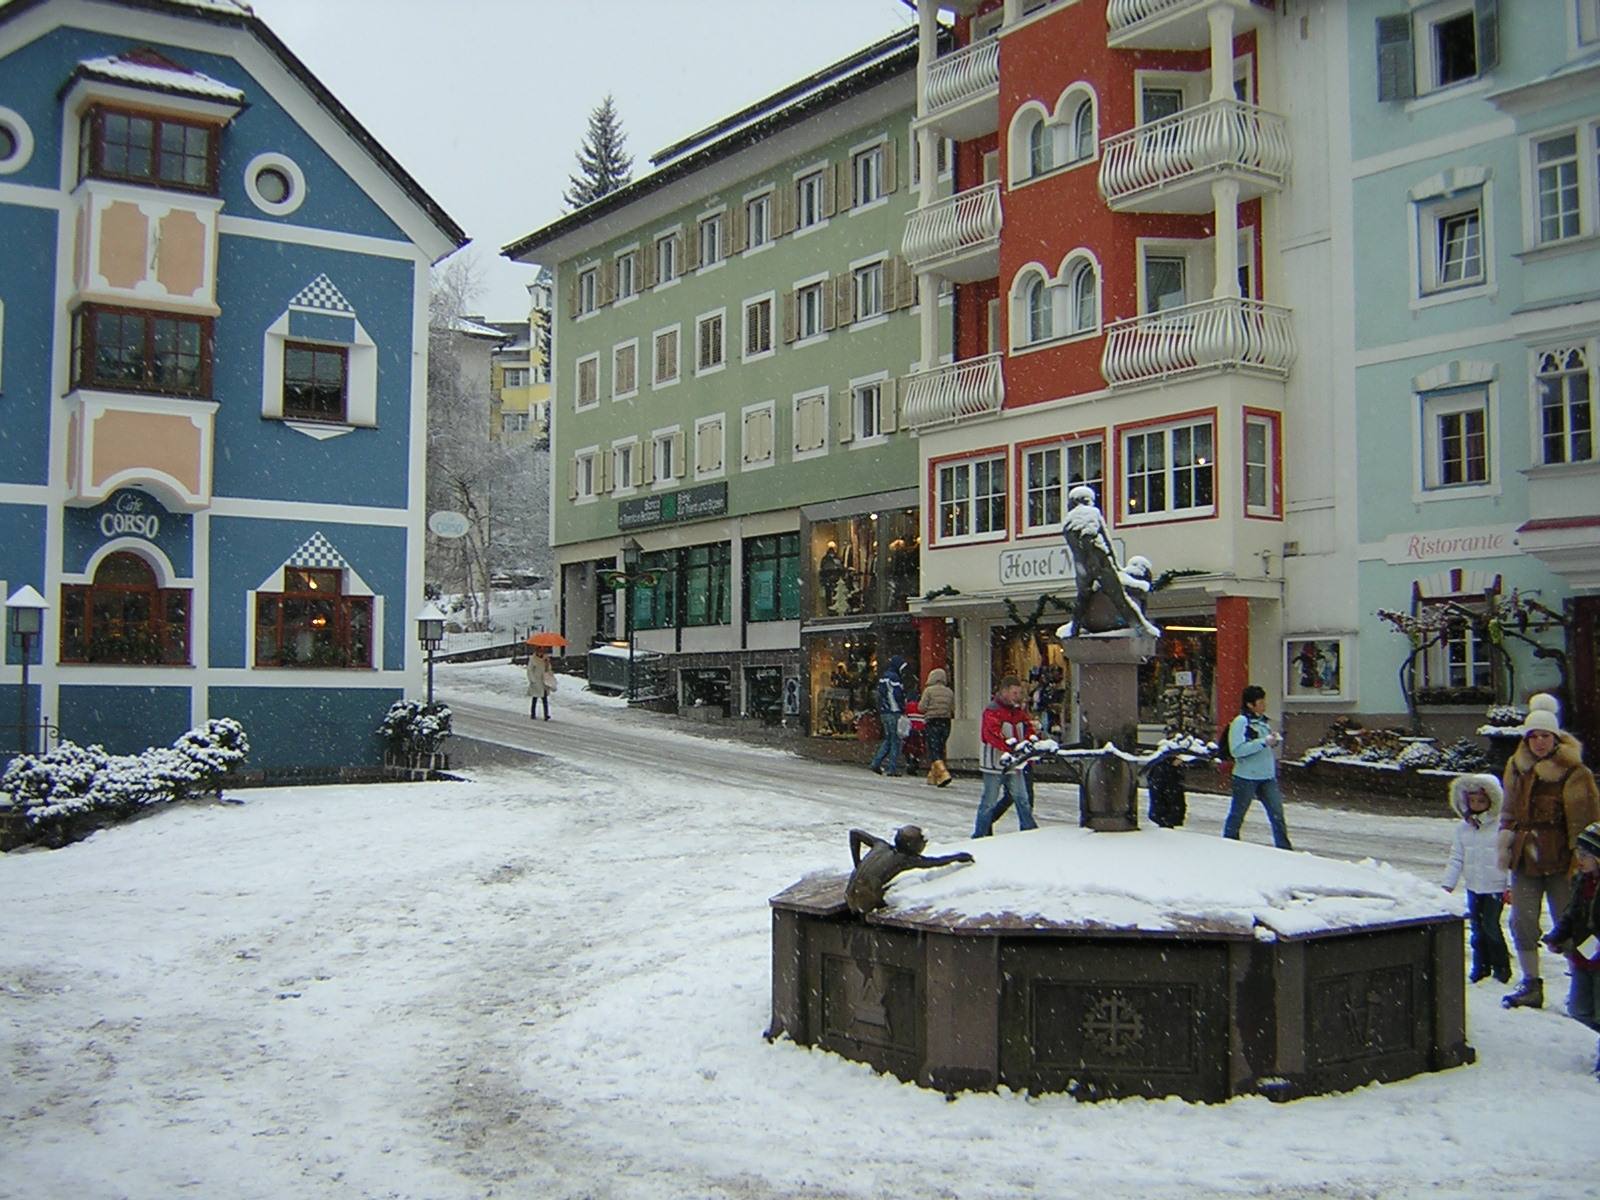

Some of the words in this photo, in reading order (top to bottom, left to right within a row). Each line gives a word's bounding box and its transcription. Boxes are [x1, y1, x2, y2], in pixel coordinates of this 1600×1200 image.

[100, 513, 159, 539] CORSO
[1407, 533, 1504, 560] Ristorante
[1004, 550, 1054, 579] Hotel
